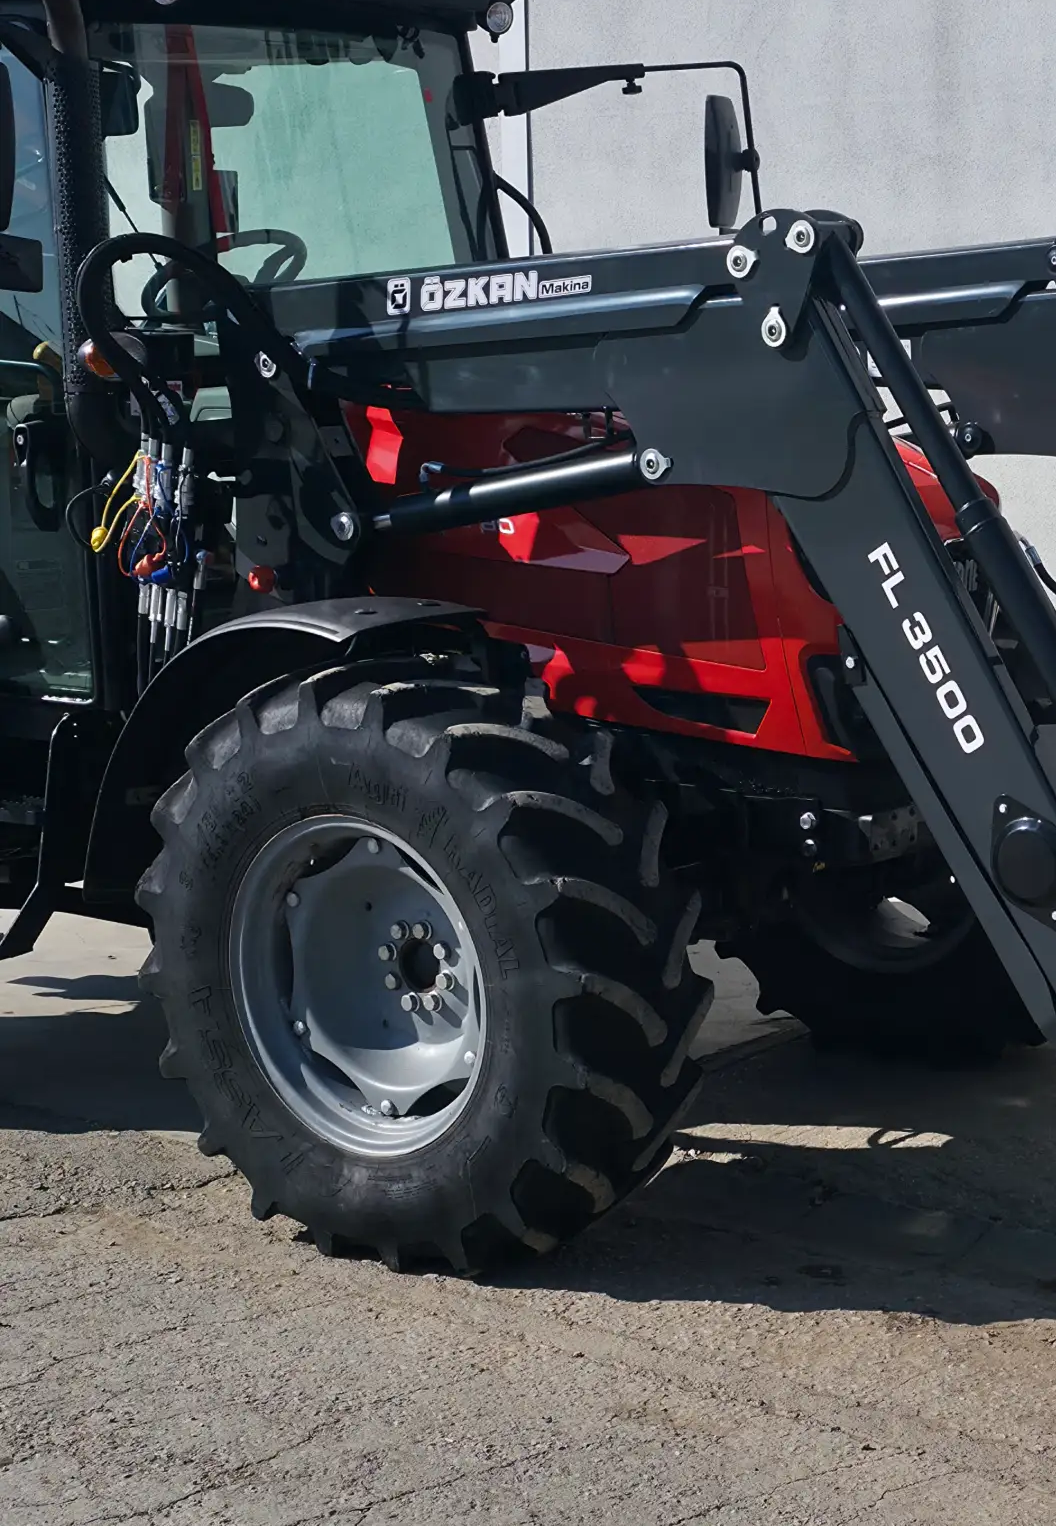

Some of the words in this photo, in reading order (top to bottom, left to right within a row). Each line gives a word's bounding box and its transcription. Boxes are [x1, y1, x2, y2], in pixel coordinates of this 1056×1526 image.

[420, 270, 538, 312] ÖZKAN
[541, 280, 589, 296] Makina
[867, 541, 905, 609] FL
[901, 611, 985, 754] 3500
